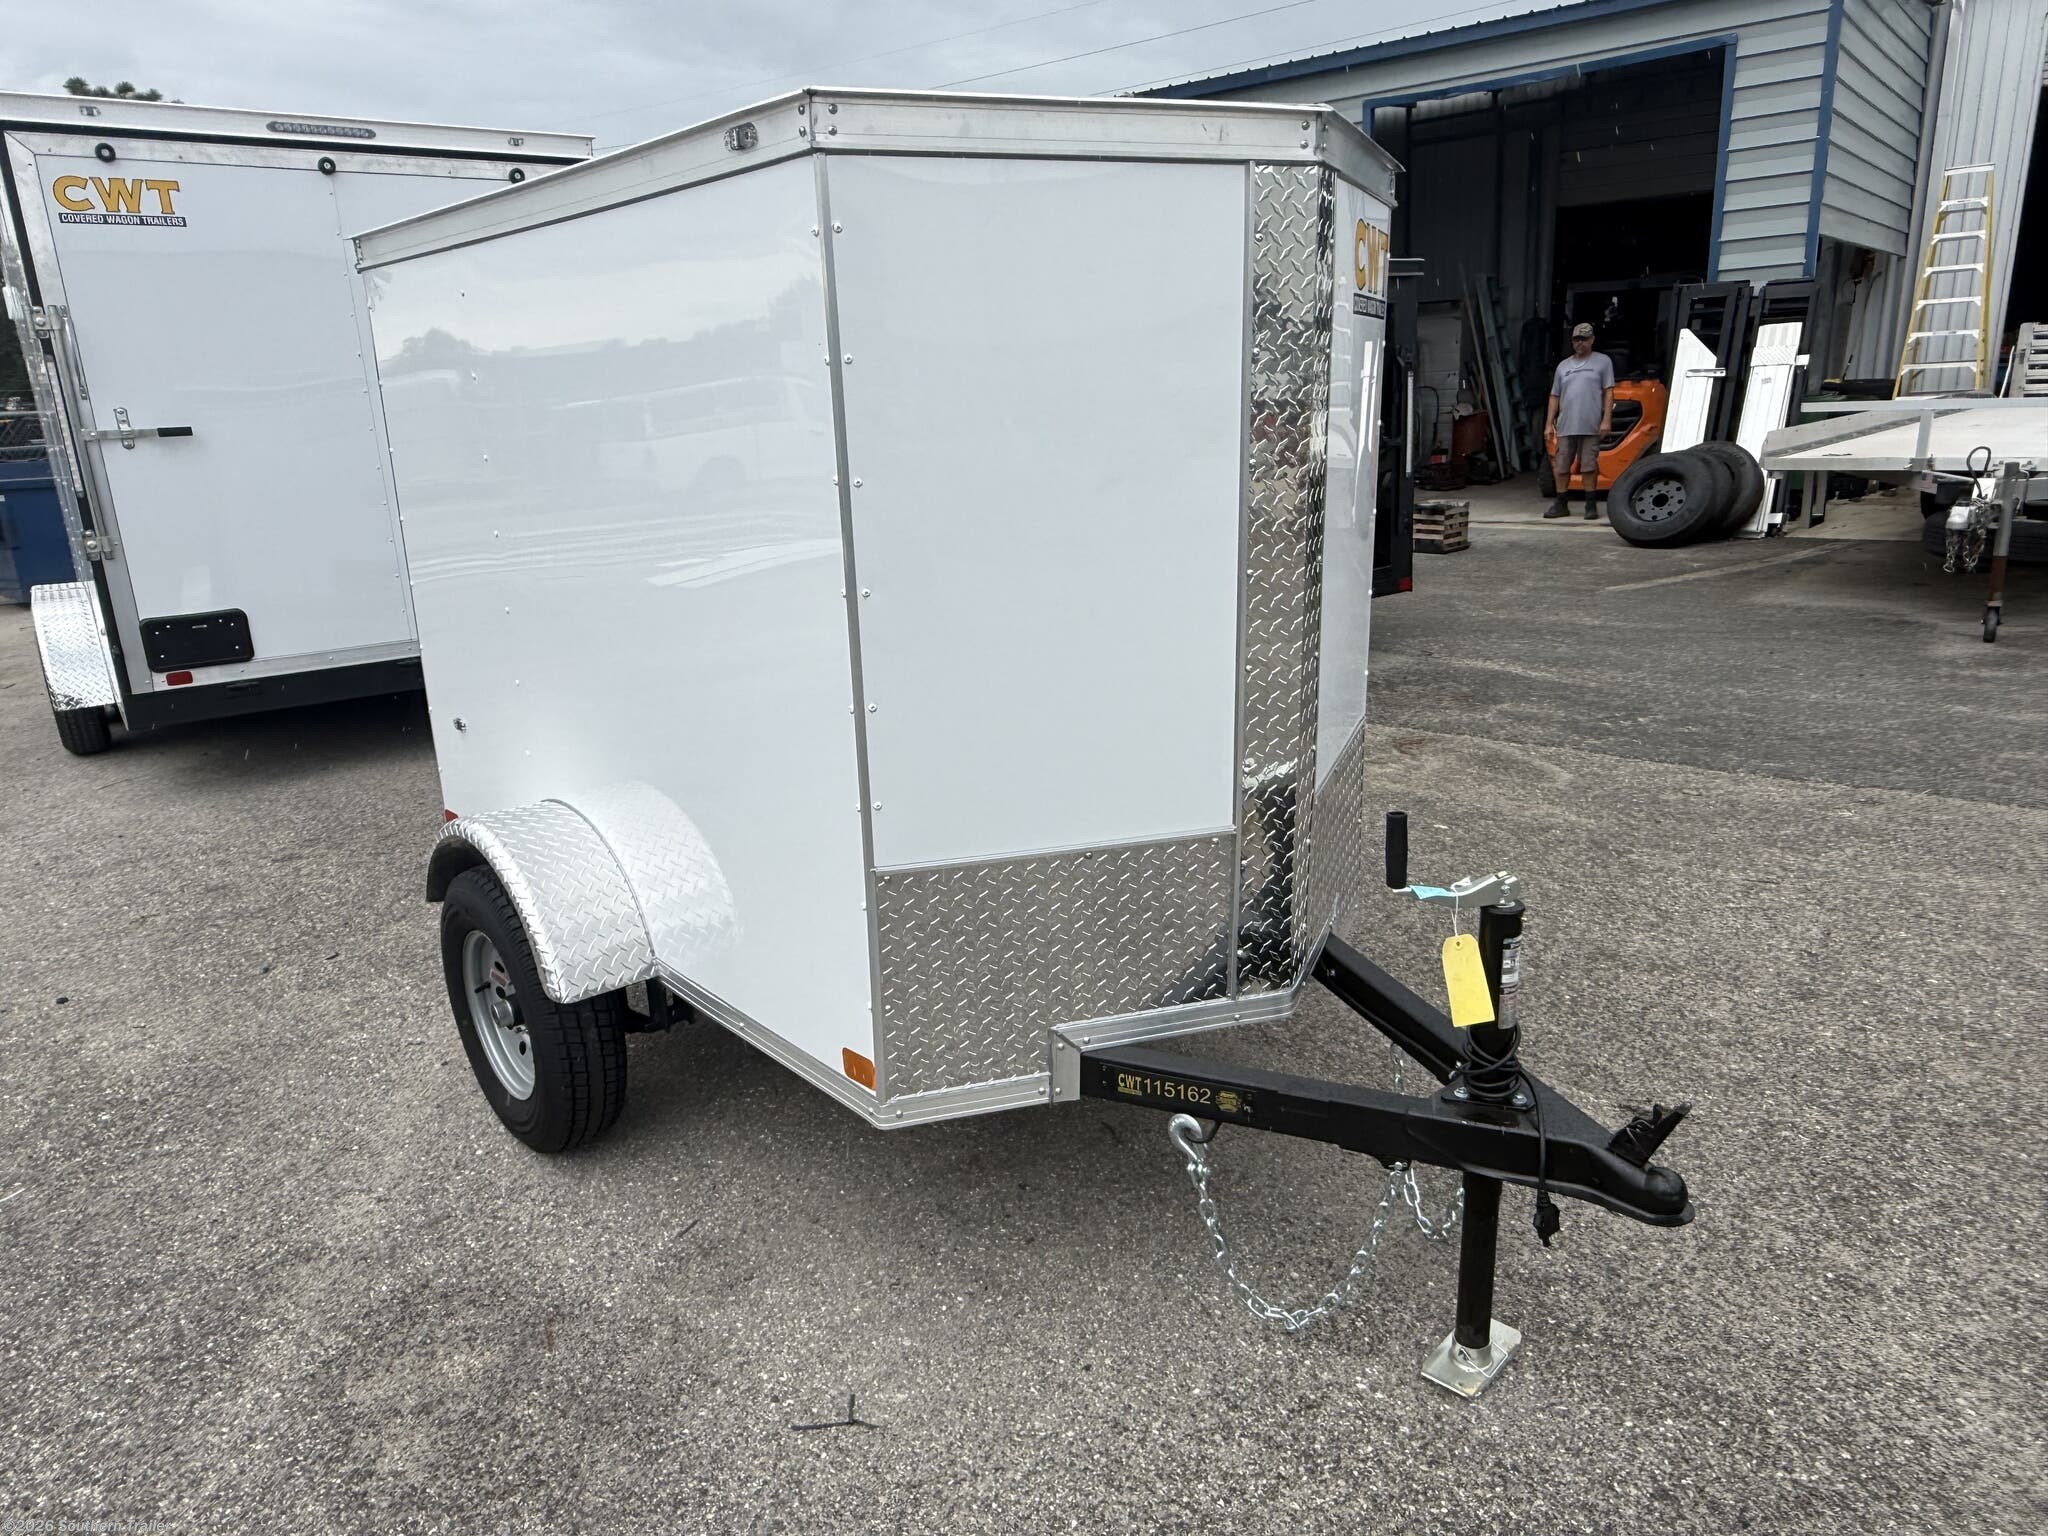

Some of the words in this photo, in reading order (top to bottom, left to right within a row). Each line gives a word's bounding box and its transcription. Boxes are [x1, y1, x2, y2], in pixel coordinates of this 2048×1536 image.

[53, 175, 180, 215] CWT
[61, 213, 103, 223] COVERED
[106, 215, 140, 225] WAGON
[141, 216, 184, 226] TRAILERS
[1355, 218, 1388, 297] CWT
